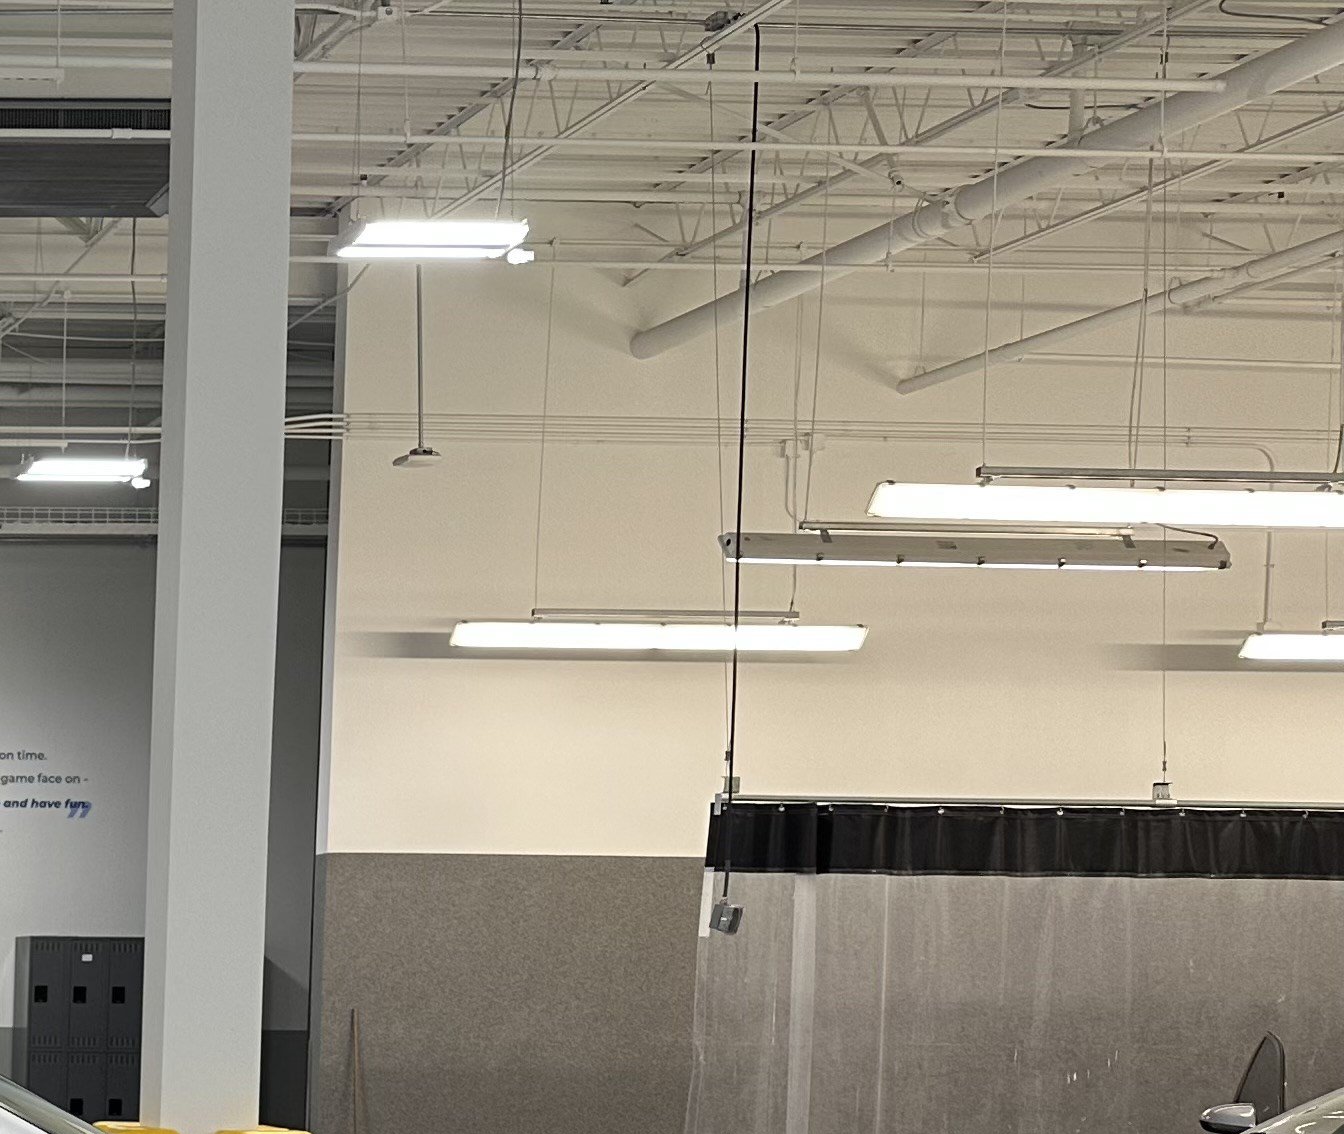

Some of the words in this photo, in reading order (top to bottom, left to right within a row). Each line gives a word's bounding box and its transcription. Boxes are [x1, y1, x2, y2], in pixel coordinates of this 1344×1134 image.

[0, 751, 14, 760] on
[17, 750, 47, 760] time.
[0, 774, 36, 785] game
[37, 772, 62, 783] face
[64, 774, 80, 783] on
[3, 798, 28, 808] and
[30, 798, 61, 808] have
